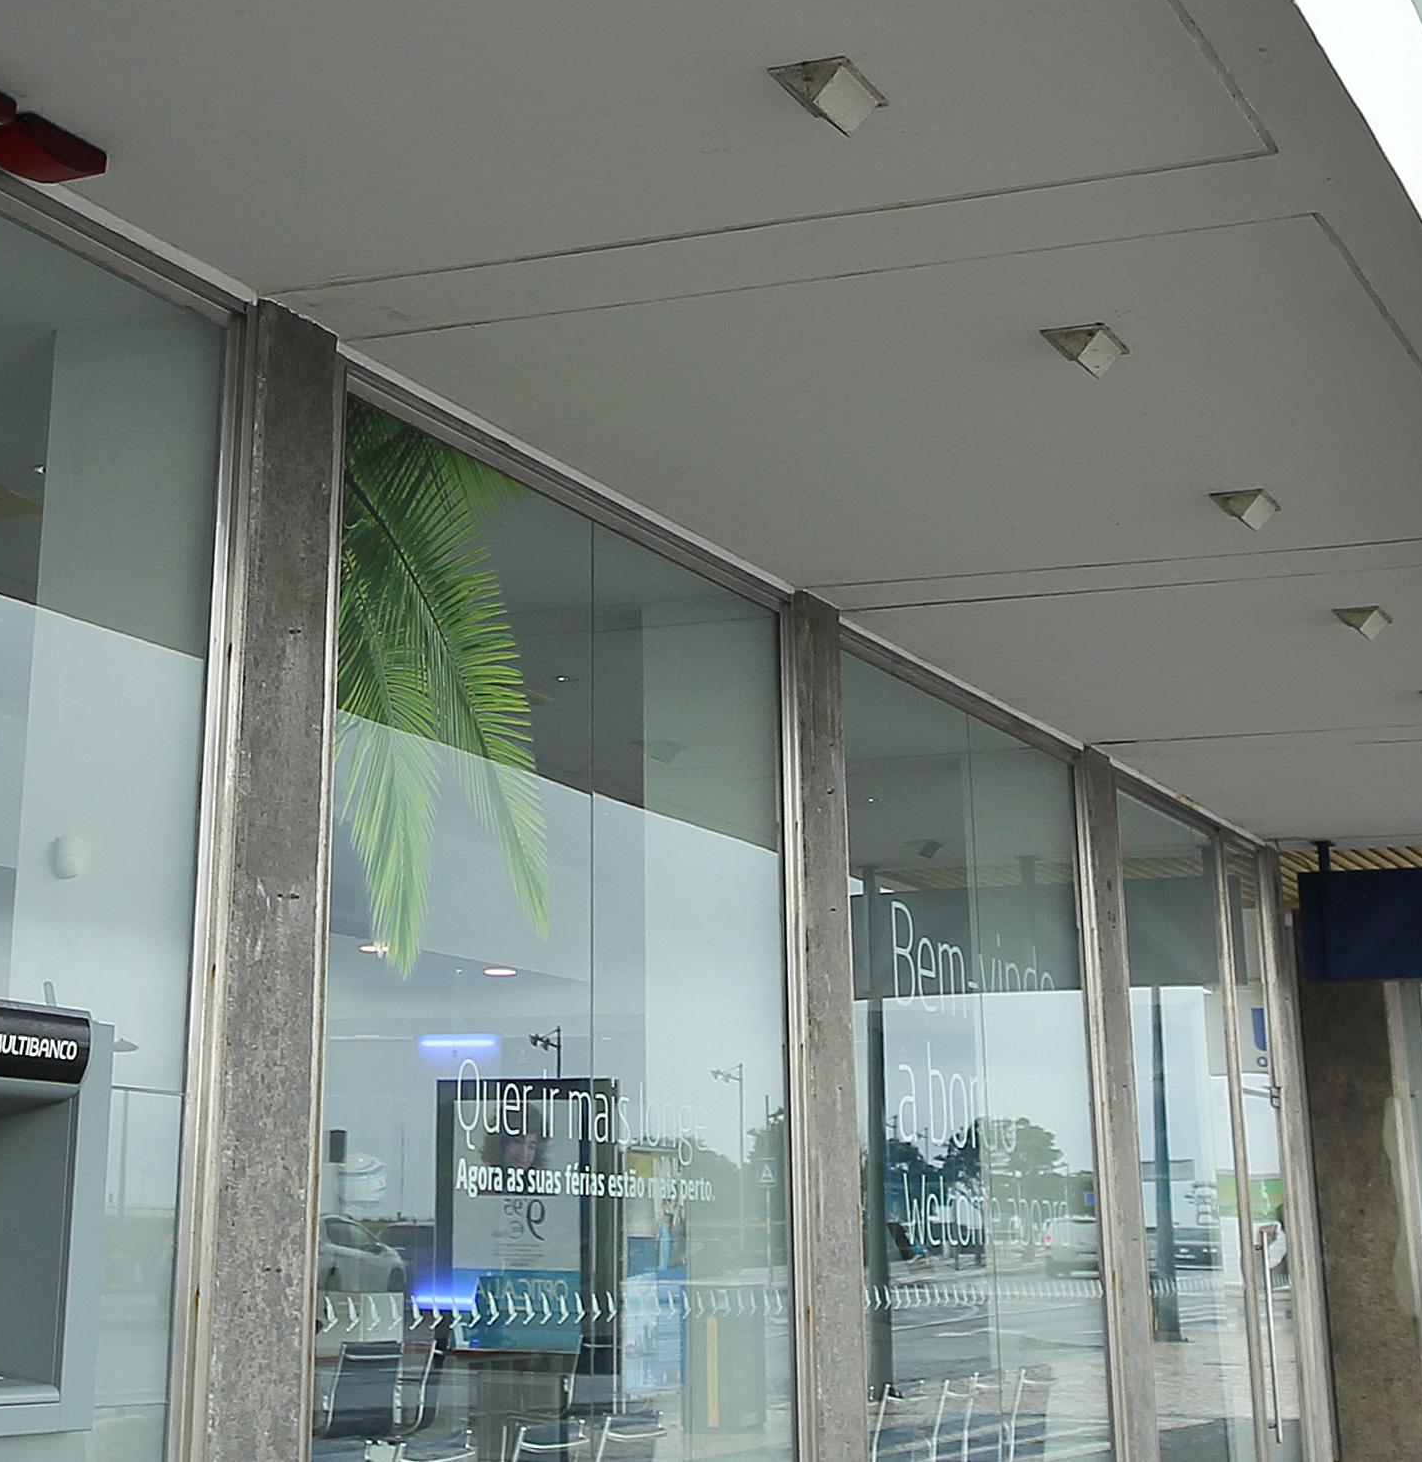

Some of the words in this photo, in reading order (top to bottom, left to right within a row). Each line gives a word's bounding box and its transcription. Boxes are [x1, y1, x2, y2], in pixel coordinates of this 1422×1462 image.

[457, 1059, 533, 1150] Quer
[541, 1069, 559, 1139] ir
[567, 1077, 630, 1147] mais
[899, 1063, 916, 1143] a
[455, 1158, 504, 1198] Agora
[507, 1167, 524, 1193] as
[527, 1168, 562, 1195] suas
[565, 1162, 605, 1198] férias
[608, 1170, 644, 1198] estão
[648, 1170, 678, 1201] mais
[903, 1173, 1000, 1247] Welcome
